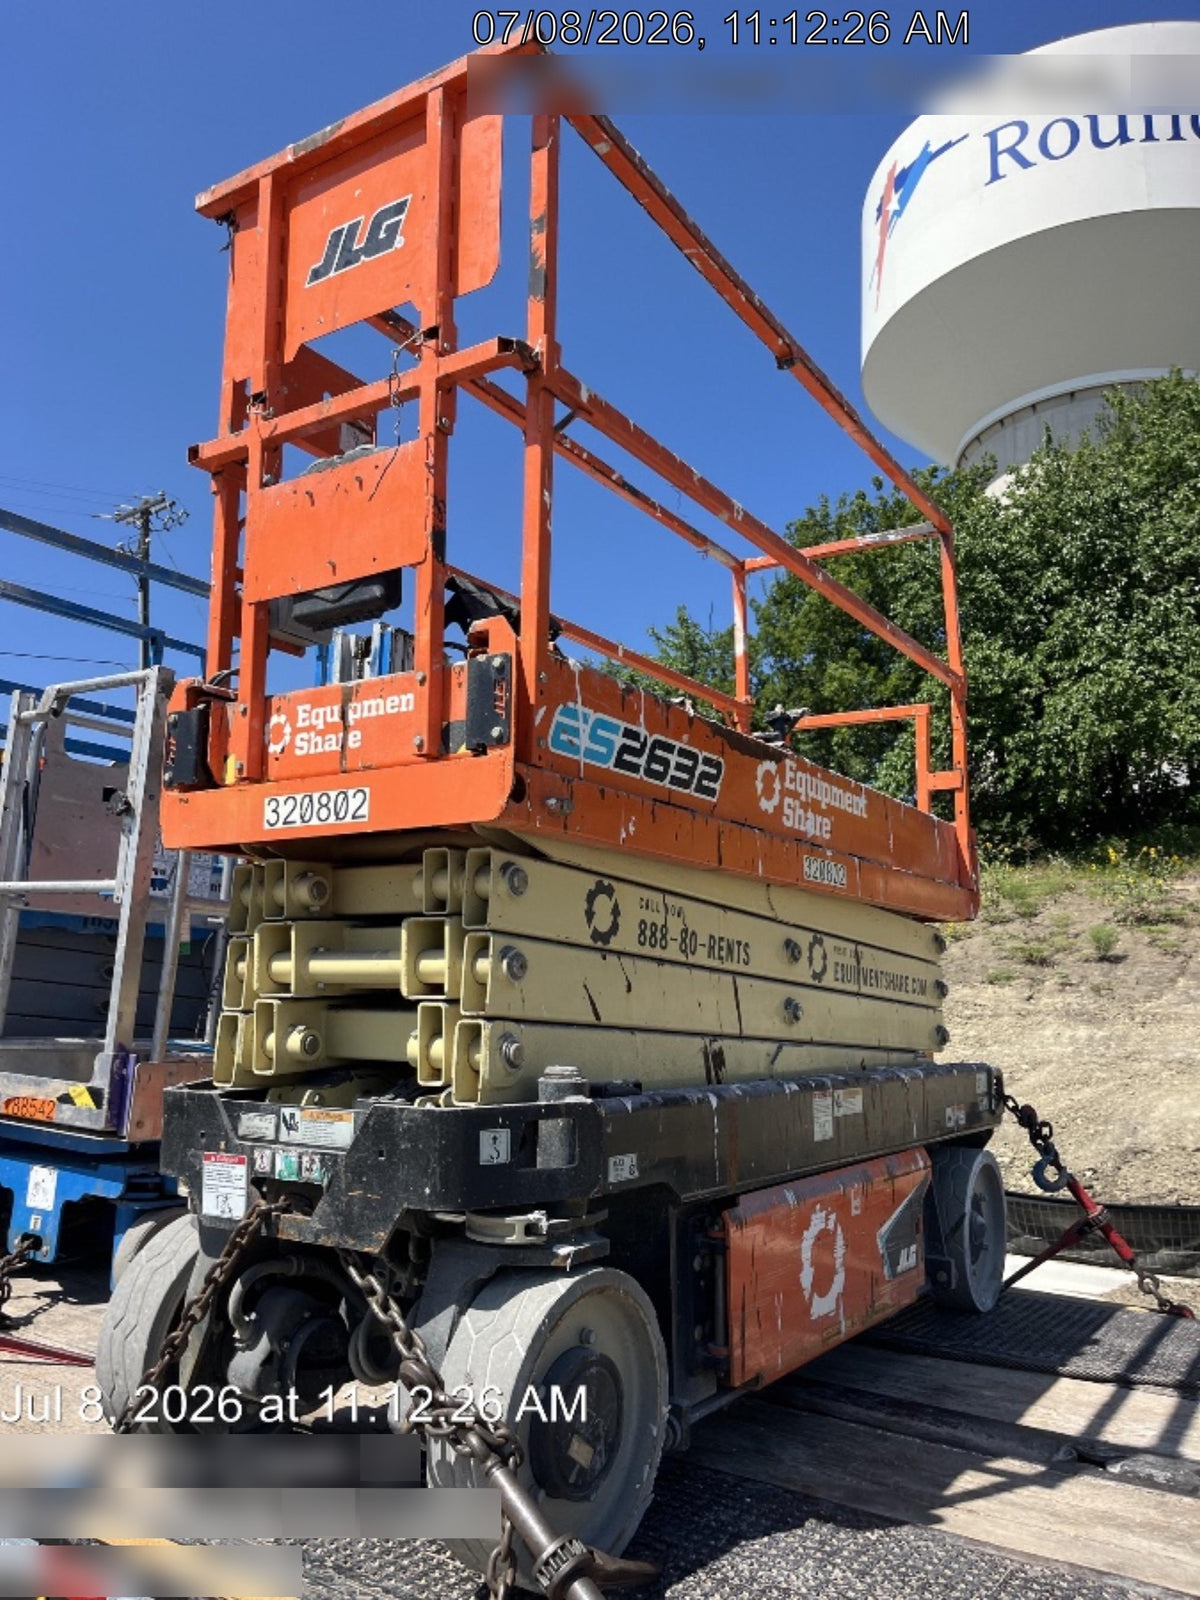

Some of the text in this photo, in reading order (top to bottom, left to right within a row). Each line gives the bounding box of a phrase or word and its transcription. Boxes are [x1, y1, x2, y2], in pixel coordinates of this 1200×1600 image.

[983, 114, 1200, 187] Roun
[305, 194, 412, 288] JLG
[296, 692, 414, 728] Equpmen
[549, 702, 725, 803] ES2632
[265, 788, 367, 828] 320802
[784, 758, 869, 819] Equipment
[782, 796, 832, 840] Share
[637, 918, 751, 967] 888-80-RENTS
[896, 1243, 917, 1274] JLG
